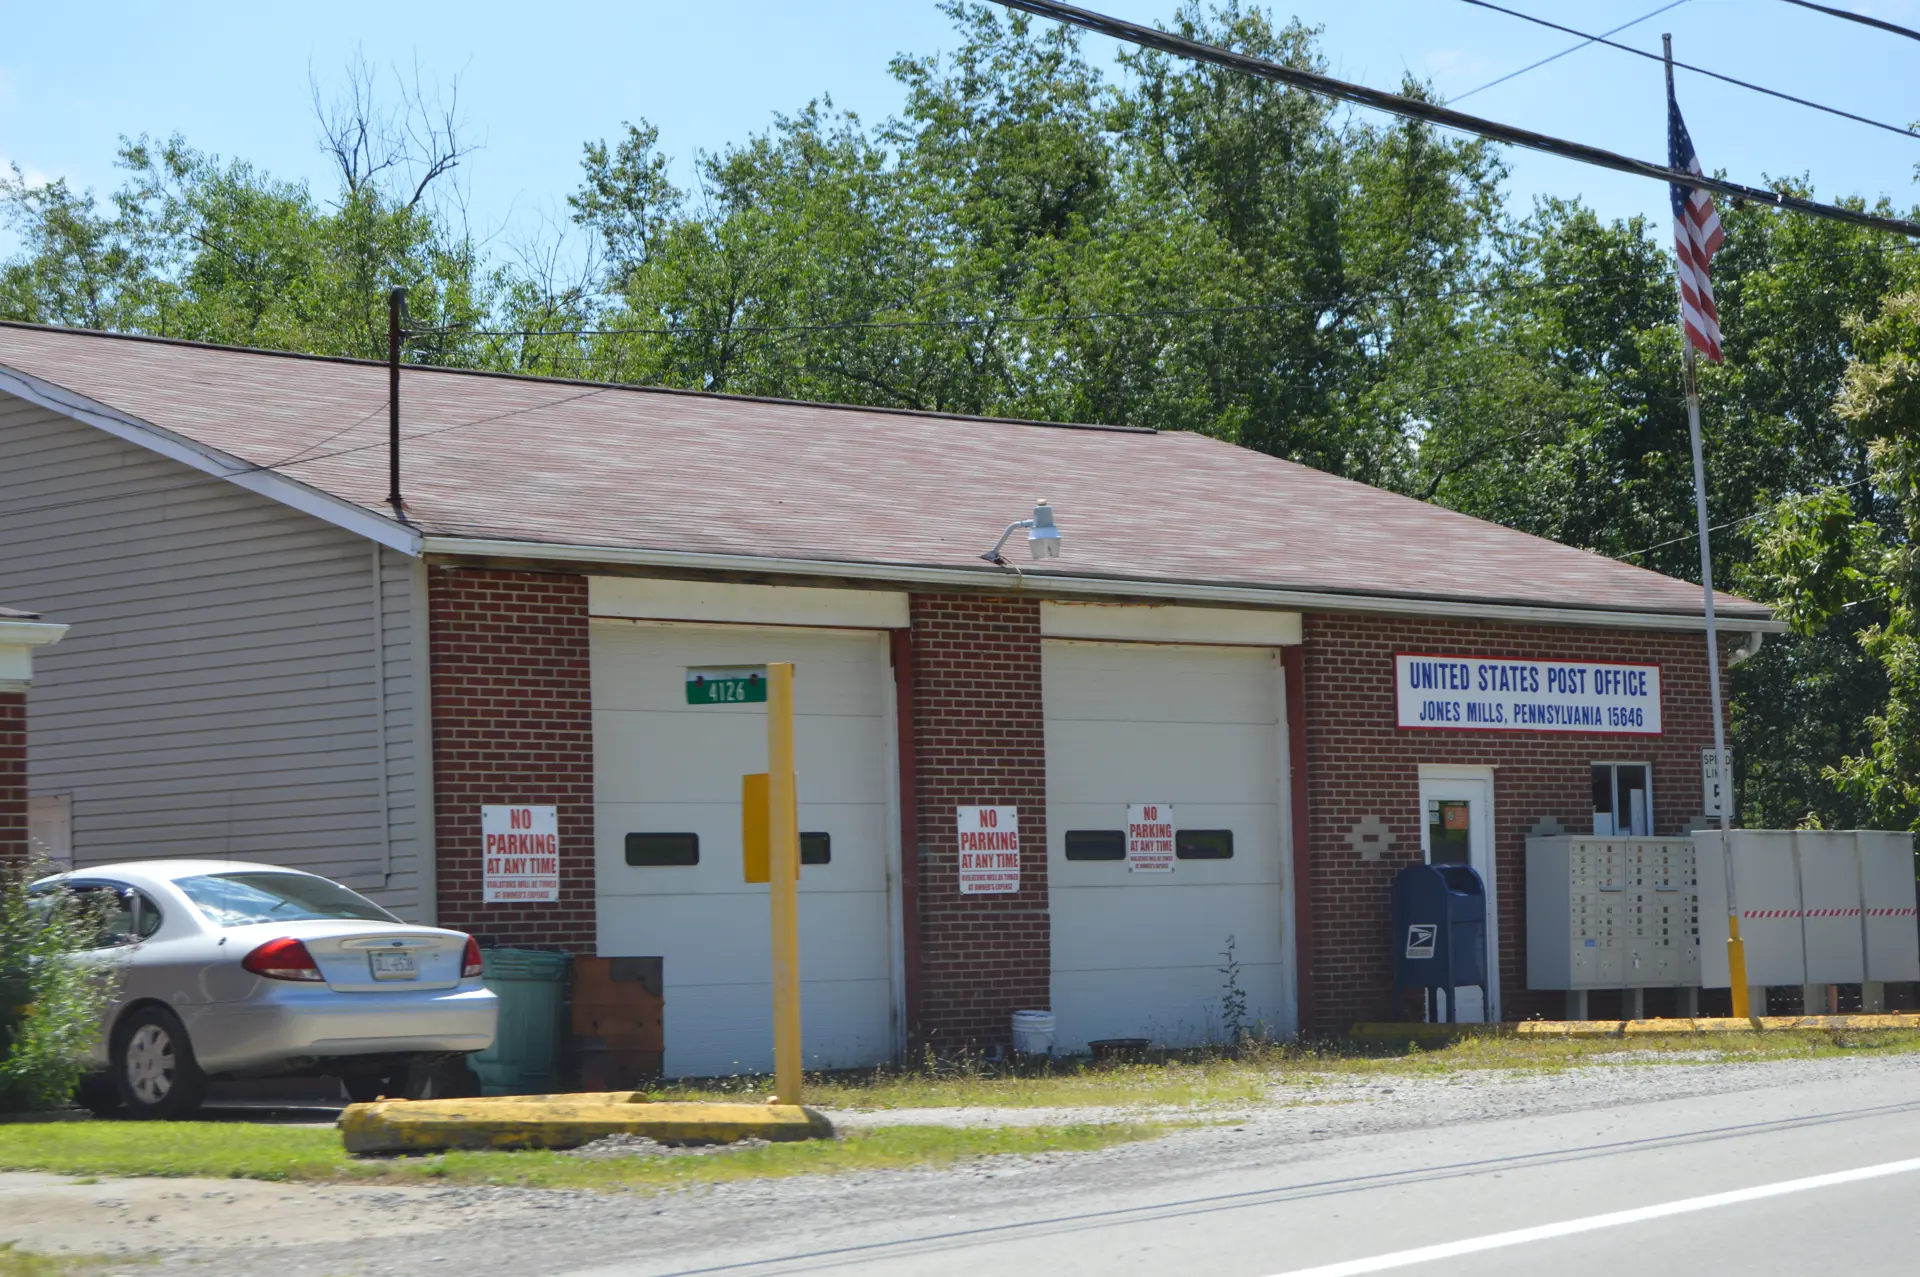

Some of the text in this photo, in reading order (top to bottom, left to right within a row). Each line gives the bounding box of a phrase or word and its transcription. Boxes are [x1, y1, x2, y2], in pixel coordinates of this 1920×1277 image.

[1410, 662, 1648, 696] UNITED STATES POST OFFICE
[708, 682, 746, 700] 4126
[1420, 700, 1642, 726] JONES MILLS, PENNSYLVANIA 15646
[1704, 754, 1730, 764] SPD
[1706, 768, 1728, 778] LIT
[510, 808, 532, 830] NO
[980, 808, 998, 828] NO
[1144, 806, 1158, 820] NO
[1130, 824, 1172, 838] PARKING
[486, 834, 556, 854] PARKING
[960, 832, 1018, 850] PARKING
[1130, 840, 1172, 852] AT ANY TIME
[486, 858, 556, 874] AT ANY TIME
[962, 854, 1018, 868] AT ANY TIME
